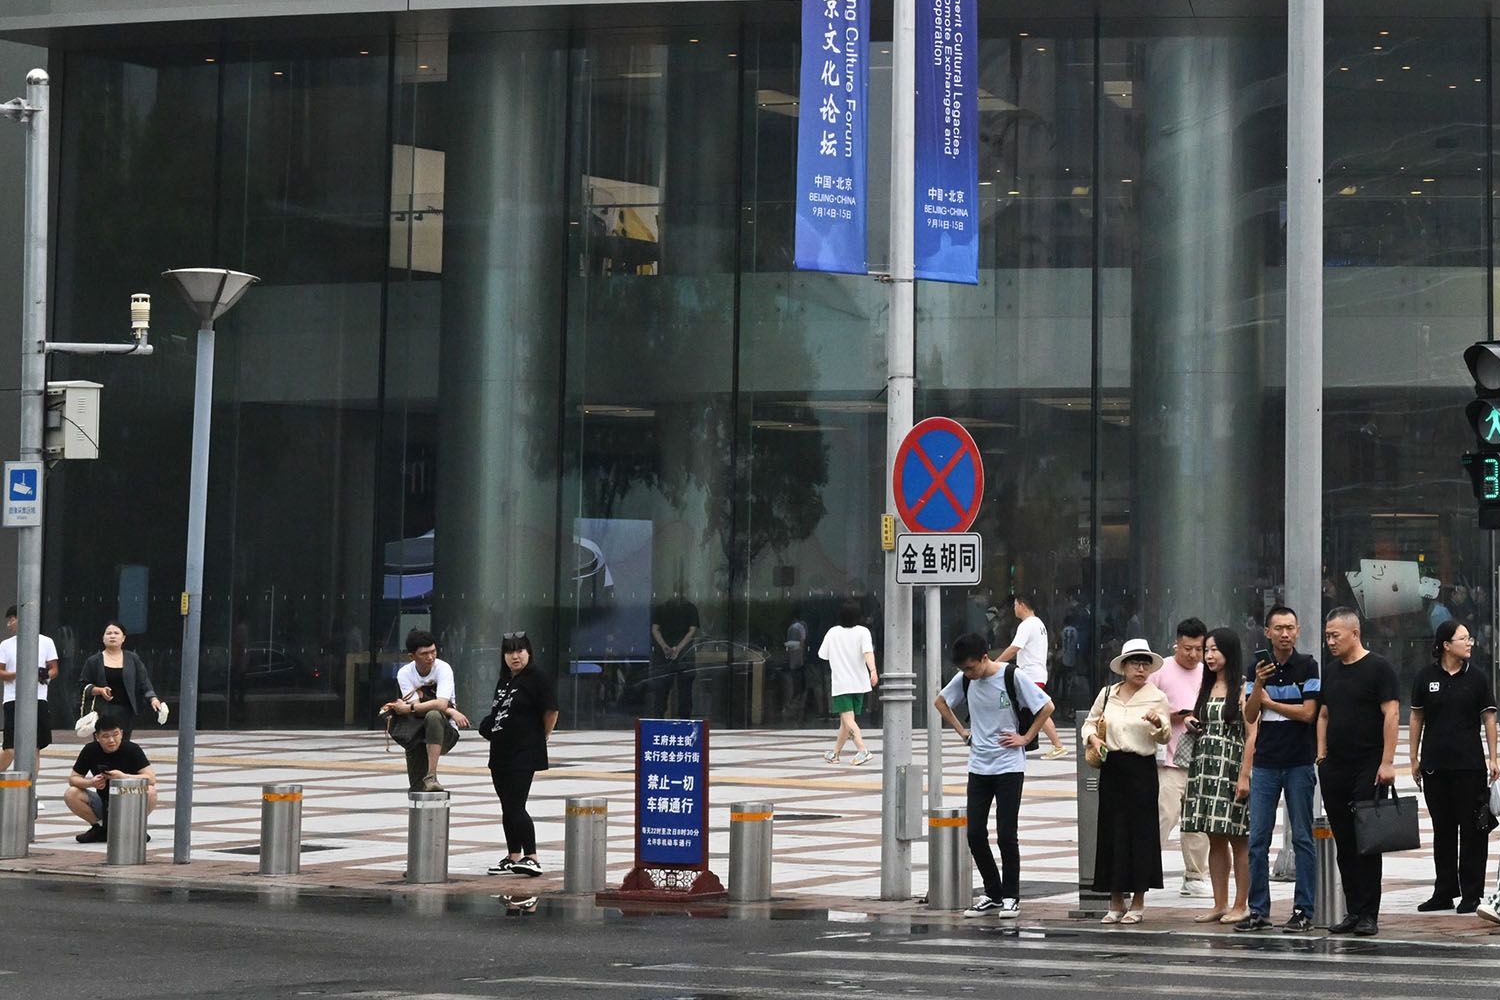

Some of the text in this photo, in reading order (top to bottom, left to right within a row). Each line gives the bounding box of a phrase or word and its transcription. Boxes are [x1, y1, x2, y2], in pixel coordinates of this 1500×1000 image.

[845, 27, 859, 93] Culture
[953, 32, 963, 88] Cultural
[943, 46, 953, 124] Exchanges
[844, 99, 857, 158] Forum
[944, 128, 953, 156] and
[814, 174, 853, 192] 中国·北京
[1484, 458, 1499, 499] 3
[901, 542, 977, 575] 金鱼胡同
[652, 735, 693, 748] 王府井主街
[644, 750, 700, 764] 实行完全步行街
[647, 775, 694, 792] 禁止一切
[647, 797, 693, 815] 车辆通行
